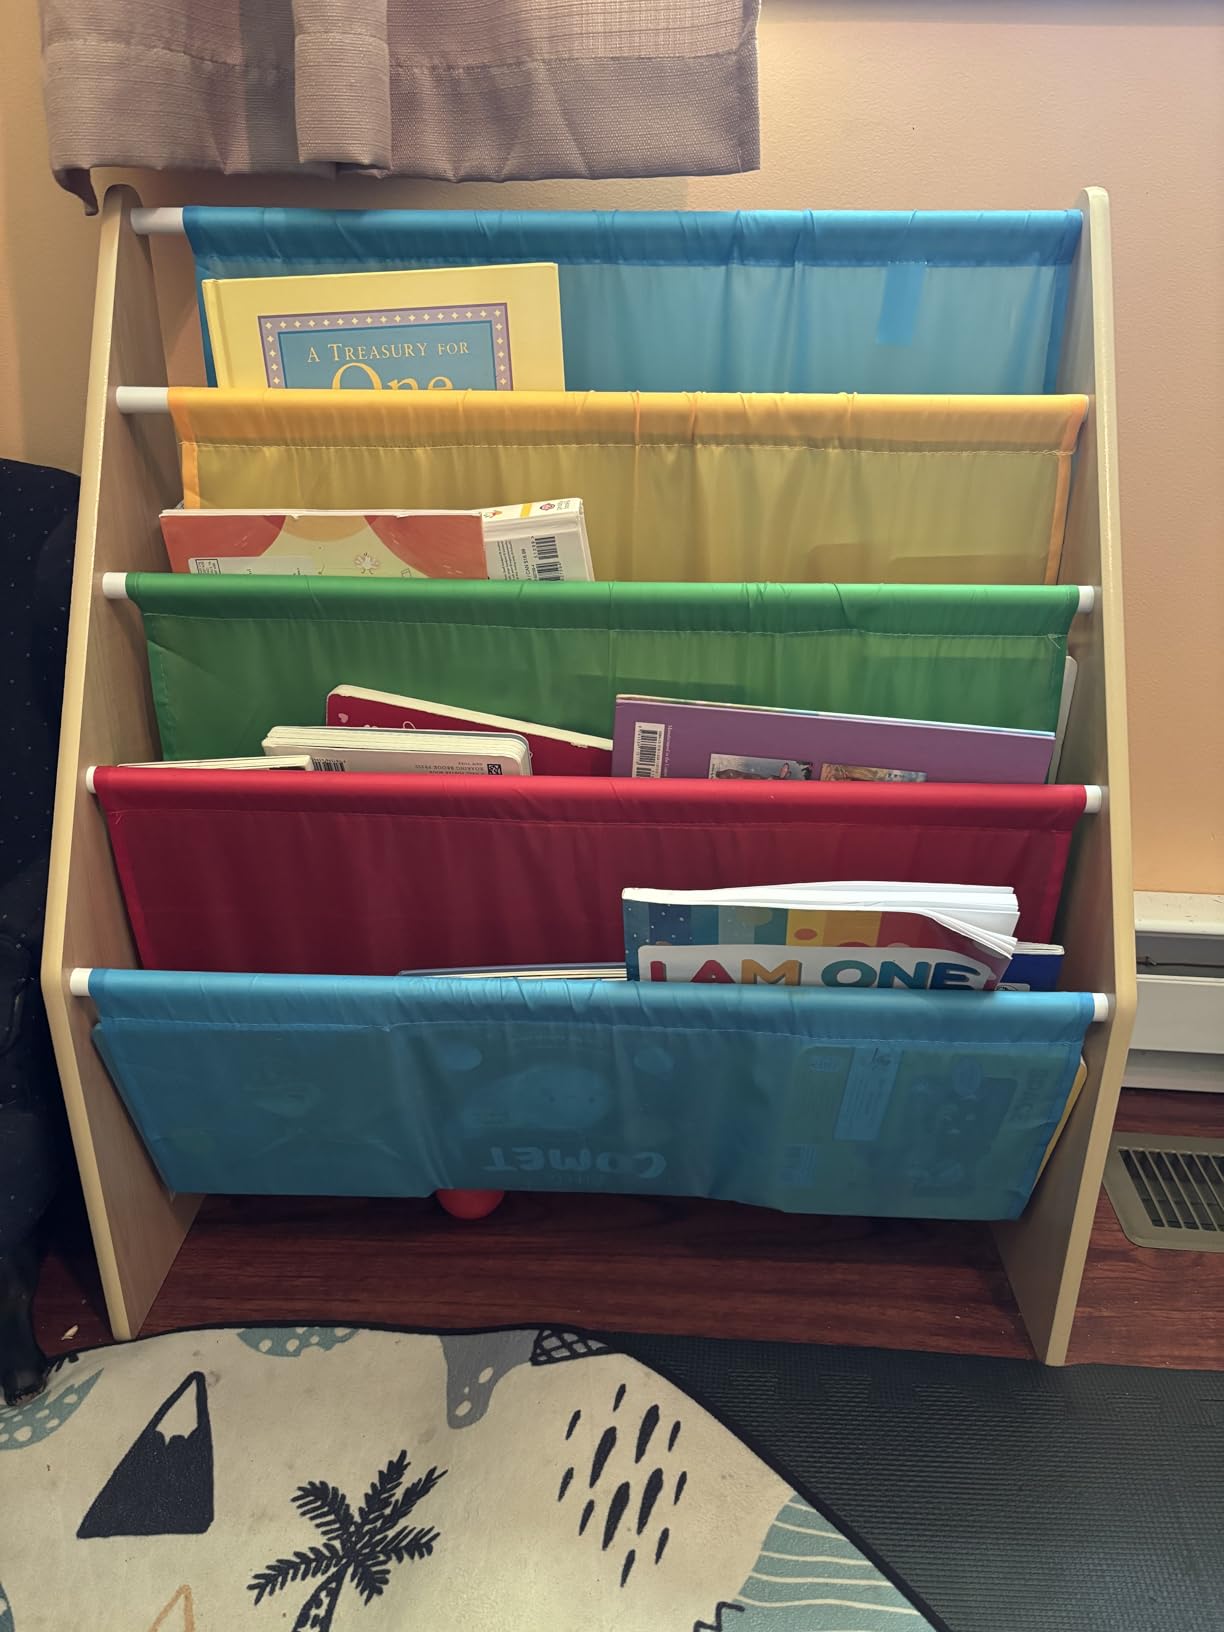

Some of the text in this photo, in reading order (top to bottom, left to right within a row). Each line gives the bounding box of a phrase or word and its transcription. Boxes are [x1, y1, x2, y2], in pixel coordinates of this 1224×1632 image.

[307, 346, 320, 363] A
[650, 959, 981, 990] I AM ONE
